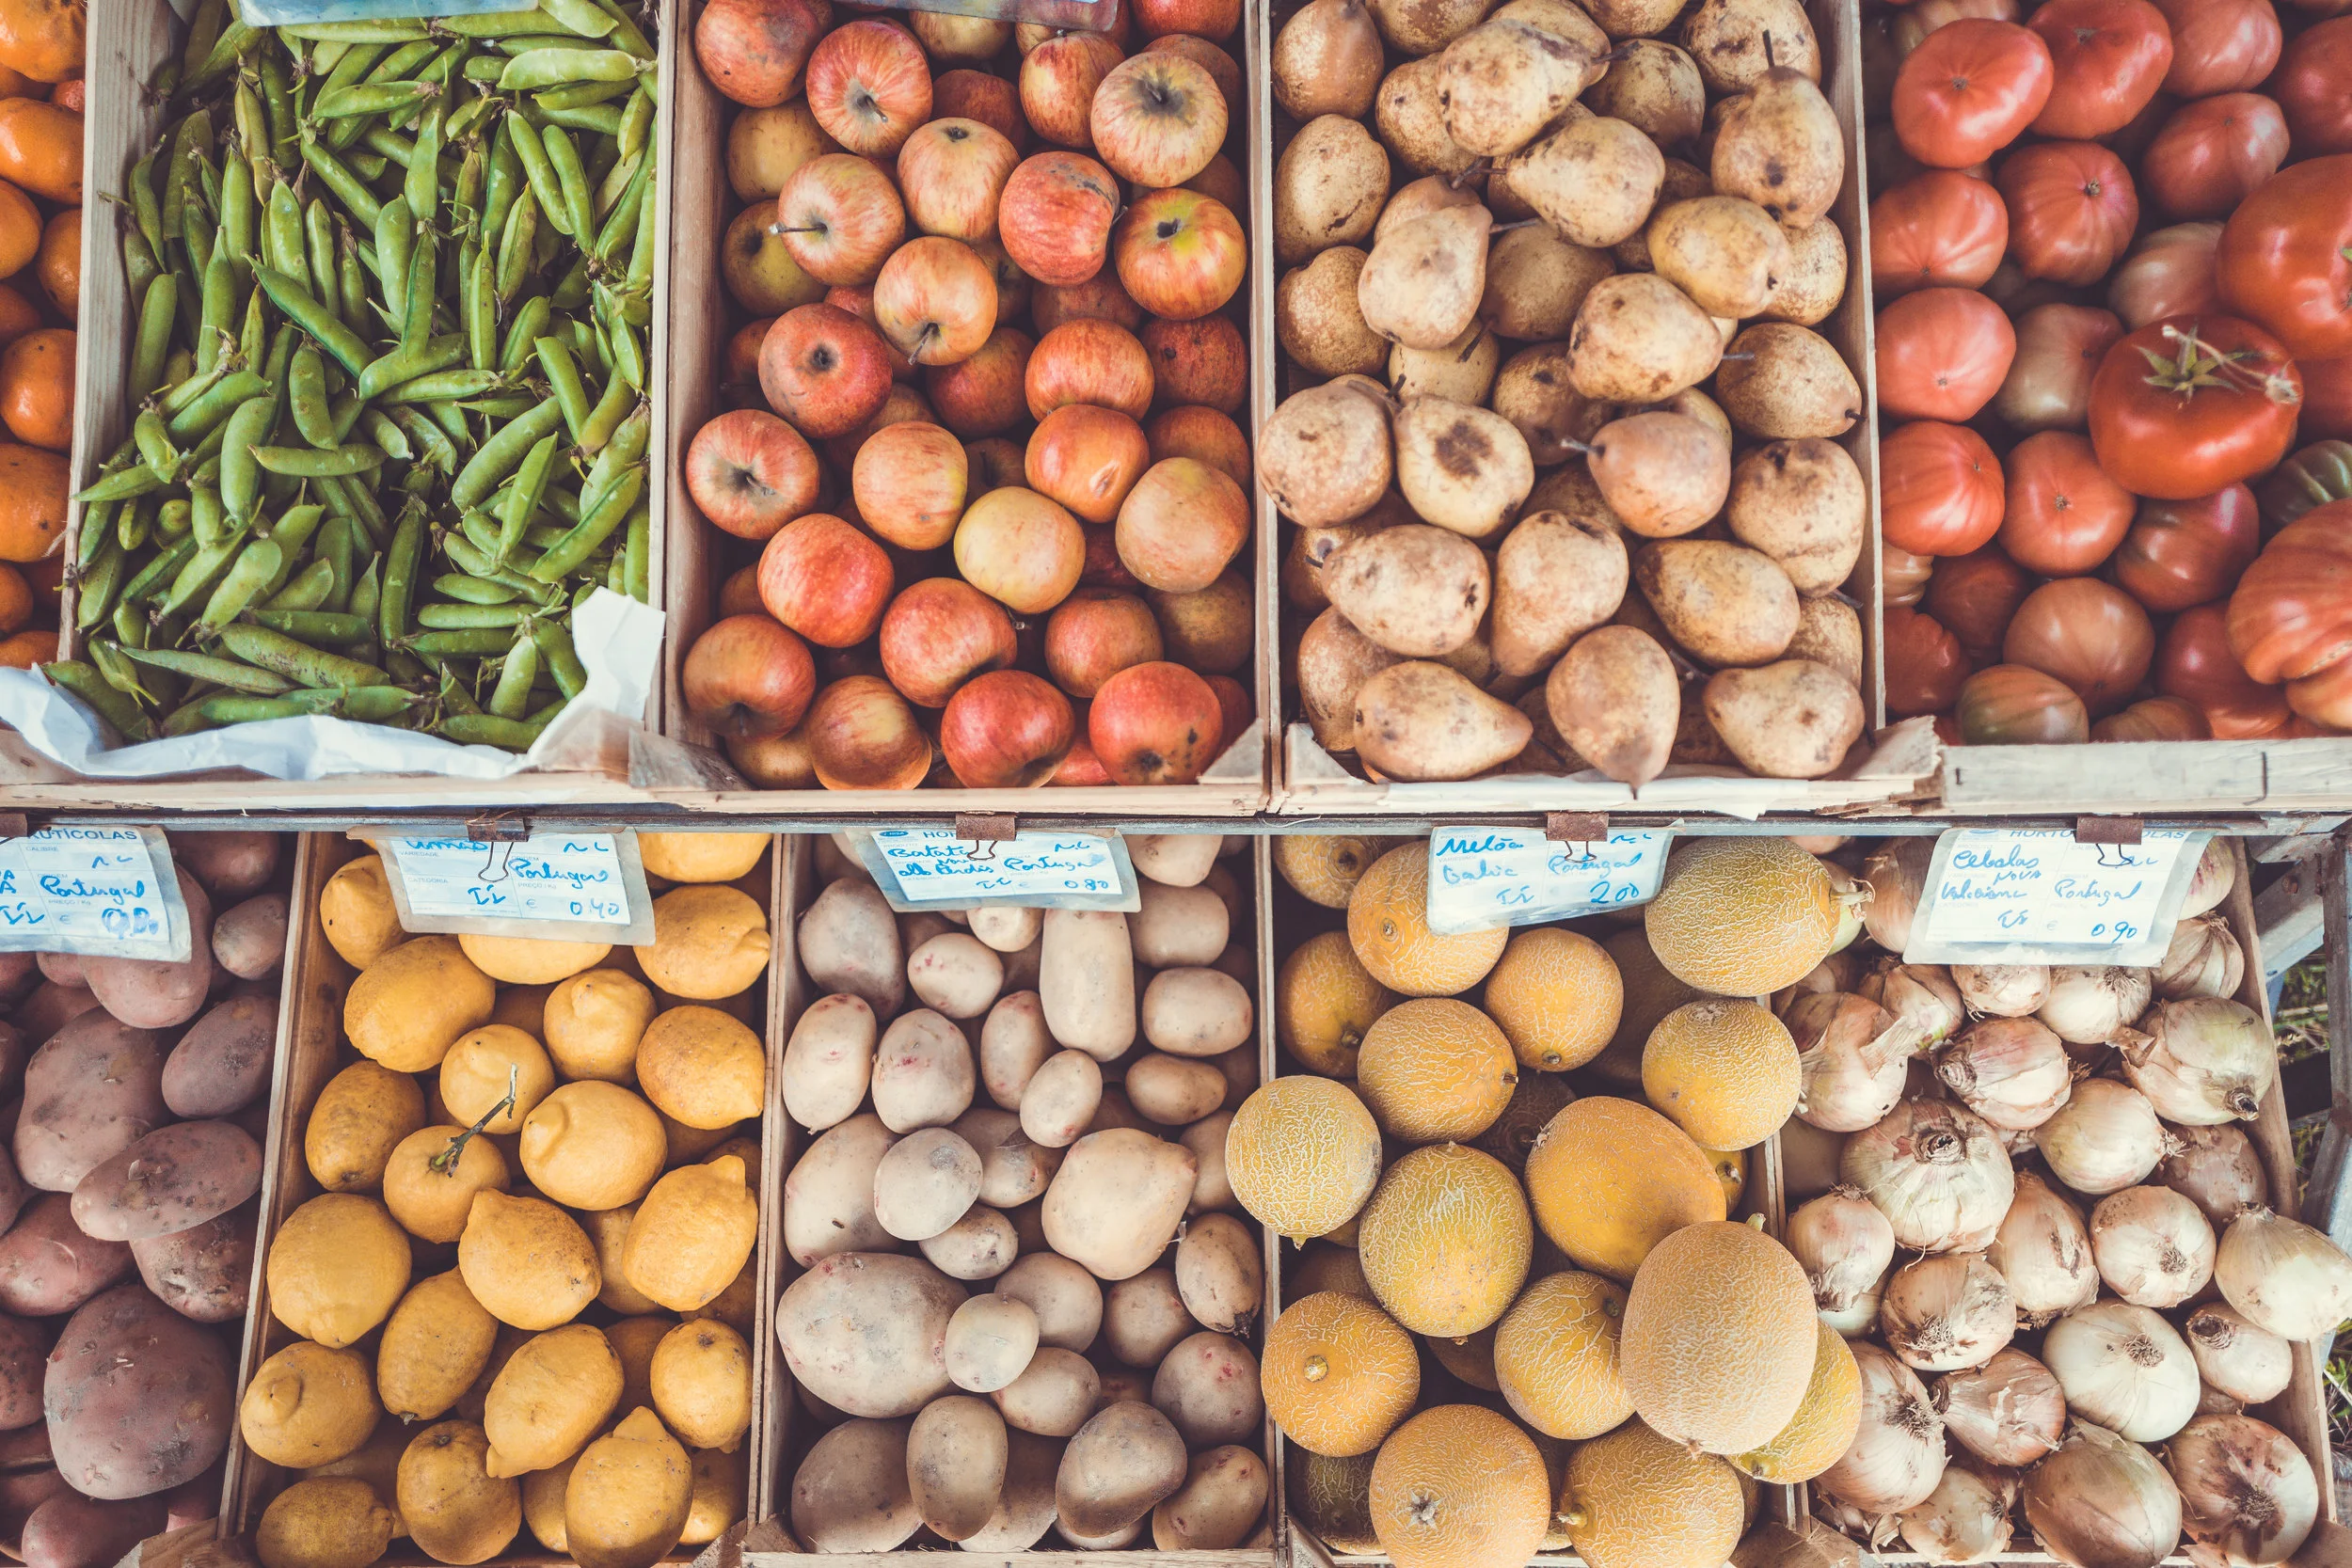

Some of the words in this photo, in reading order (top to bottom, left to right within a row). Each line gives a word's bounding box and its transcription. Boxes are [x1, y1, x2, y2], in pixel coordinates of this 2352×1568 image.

[508, 857, 609, 889] Portugal
[1548, 852, 1643, 879] Portugal
[40, 876, 146, 906] Portugal
[2055, 879, 2142, 907] Portugal
